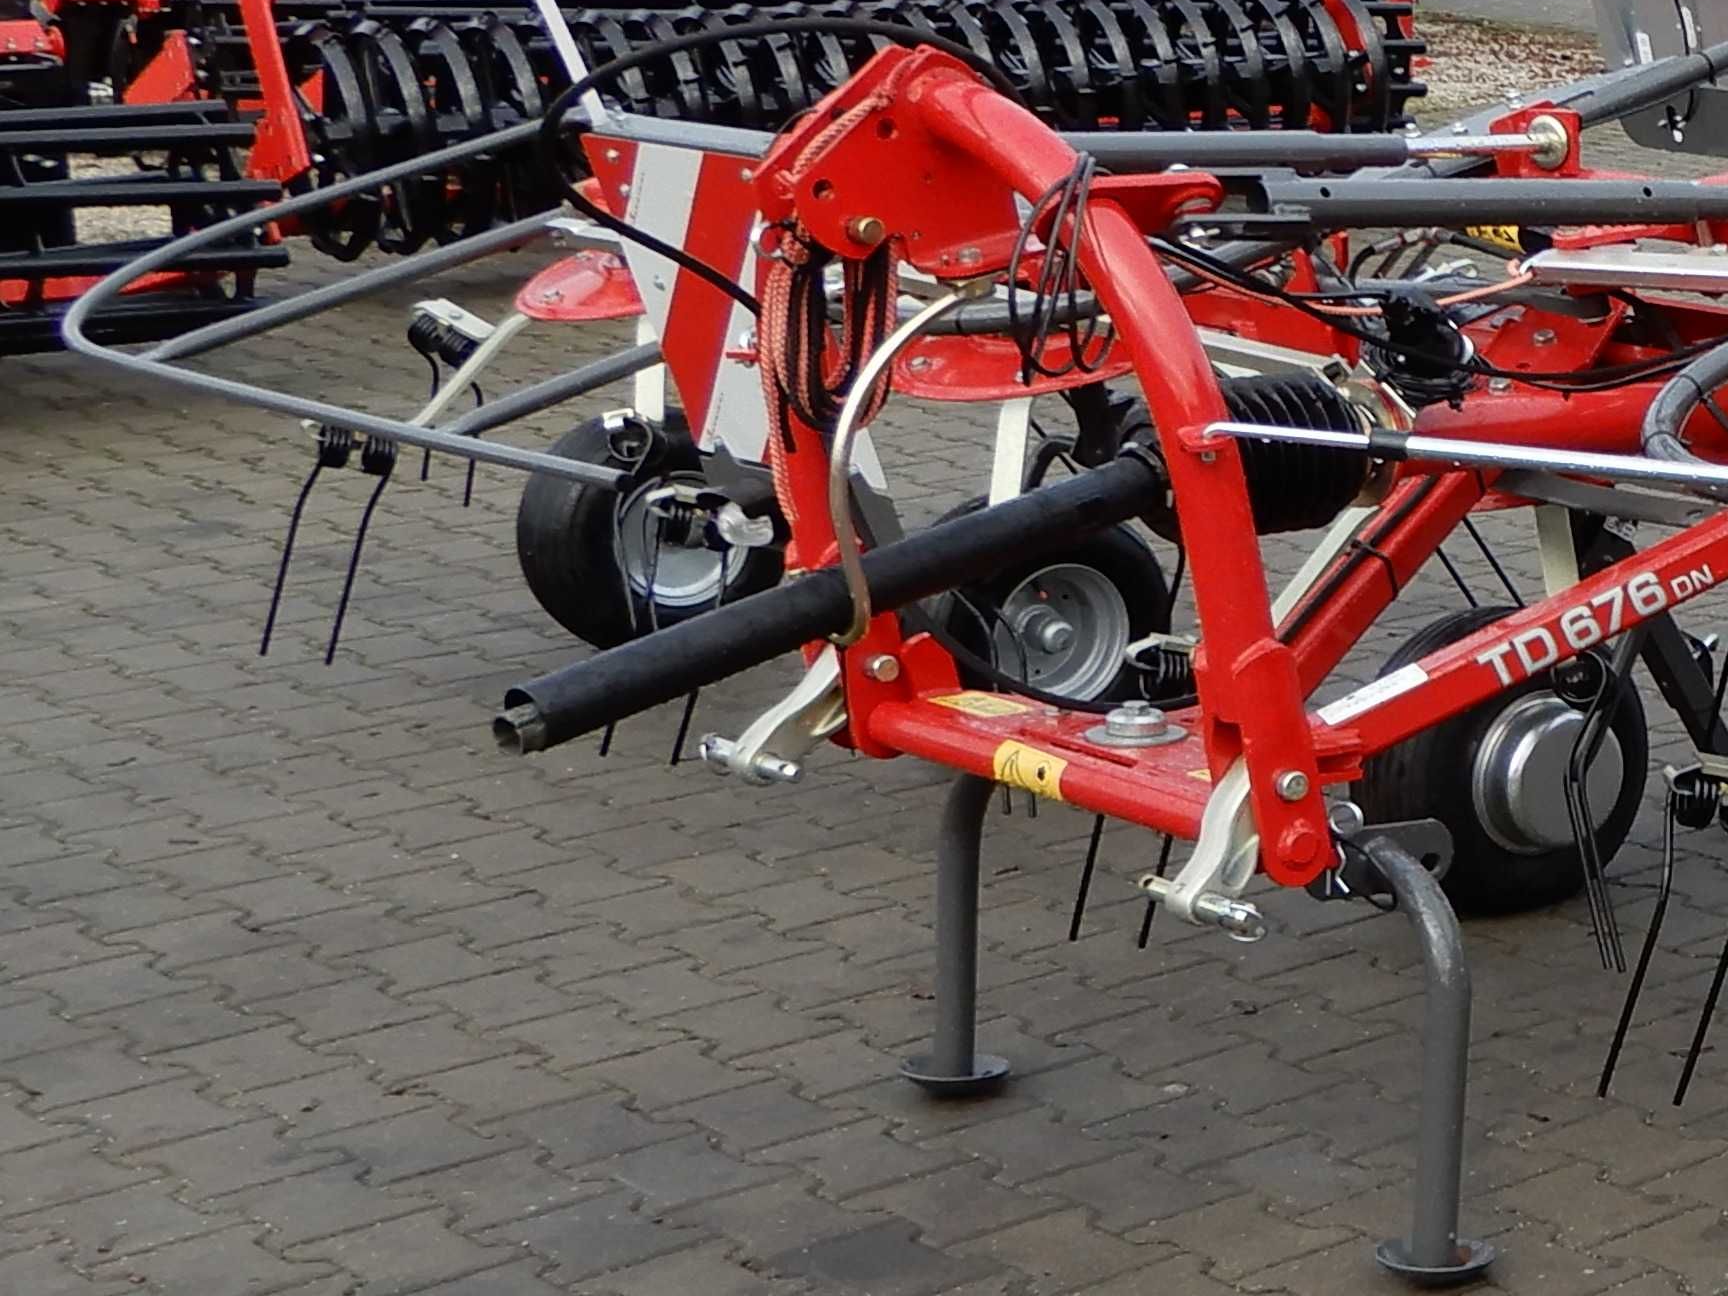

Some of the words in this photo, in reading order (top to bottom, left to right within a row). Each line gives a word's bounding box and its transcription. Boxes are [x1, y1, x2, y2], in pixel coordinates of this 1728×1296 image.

[1476, 627, 1558, 688] TD
[1559, 570, 1668, 650] 676
[1670, 562, 1715, 600] DN
